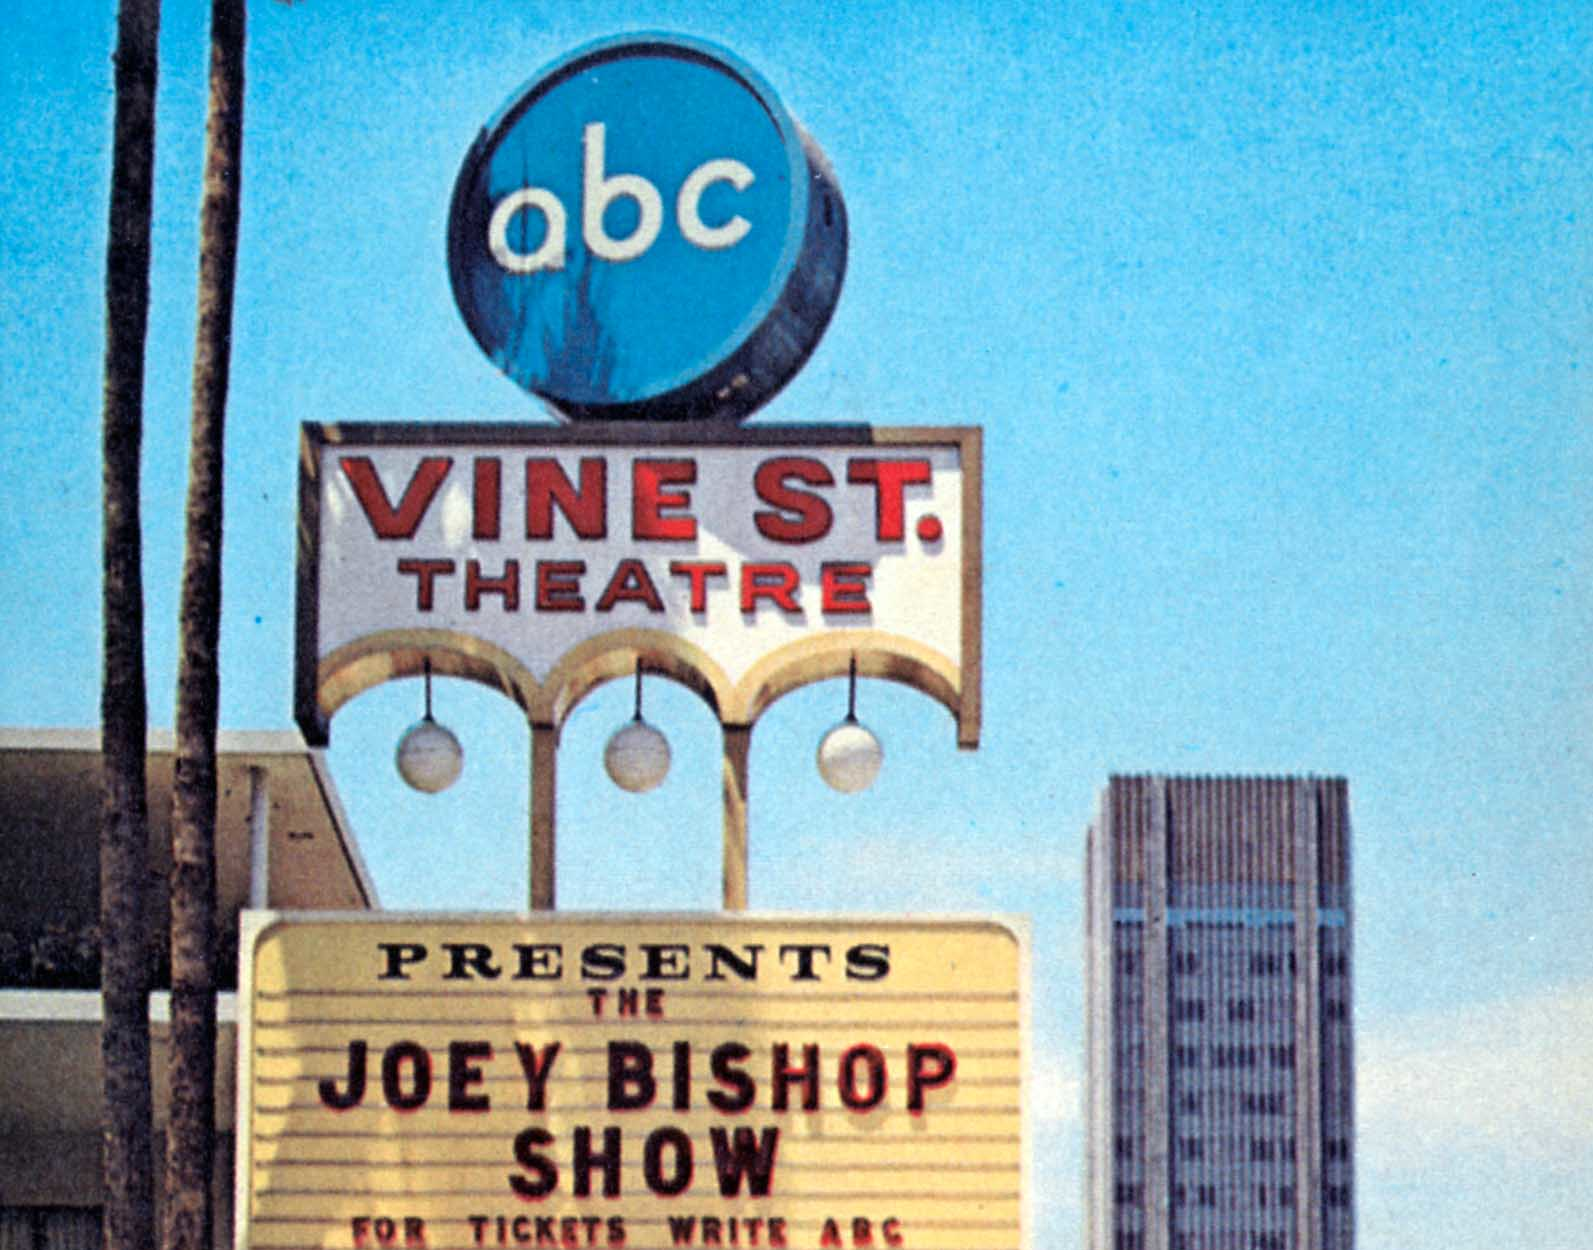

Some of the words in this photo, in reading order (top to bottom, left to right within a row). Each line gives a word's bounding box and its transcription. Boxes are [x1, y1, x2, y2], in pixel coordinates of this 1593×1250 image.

[487, 122, 756, 274] abc
[338, 456, 698, 541] VINE
[753, 457, 944, 543] ST.
[396, 558, 875, 615] THEATRE
[377, 943, 893, 981] PRESENTS
[588, 988, 665, 1017] THE
[318, 1040, 562, 1113] JOEY
[606, 1041, 958, 1114] BISHOP
[508, 1126, 781, 1198] SHOW
[351, 1216, 427, 1249] FOR
[468, 1215, 628, 1248] TICKETS
[668, 1215, 789, 1248] WRITE
[819, 1217, 905, 1249] ABC
